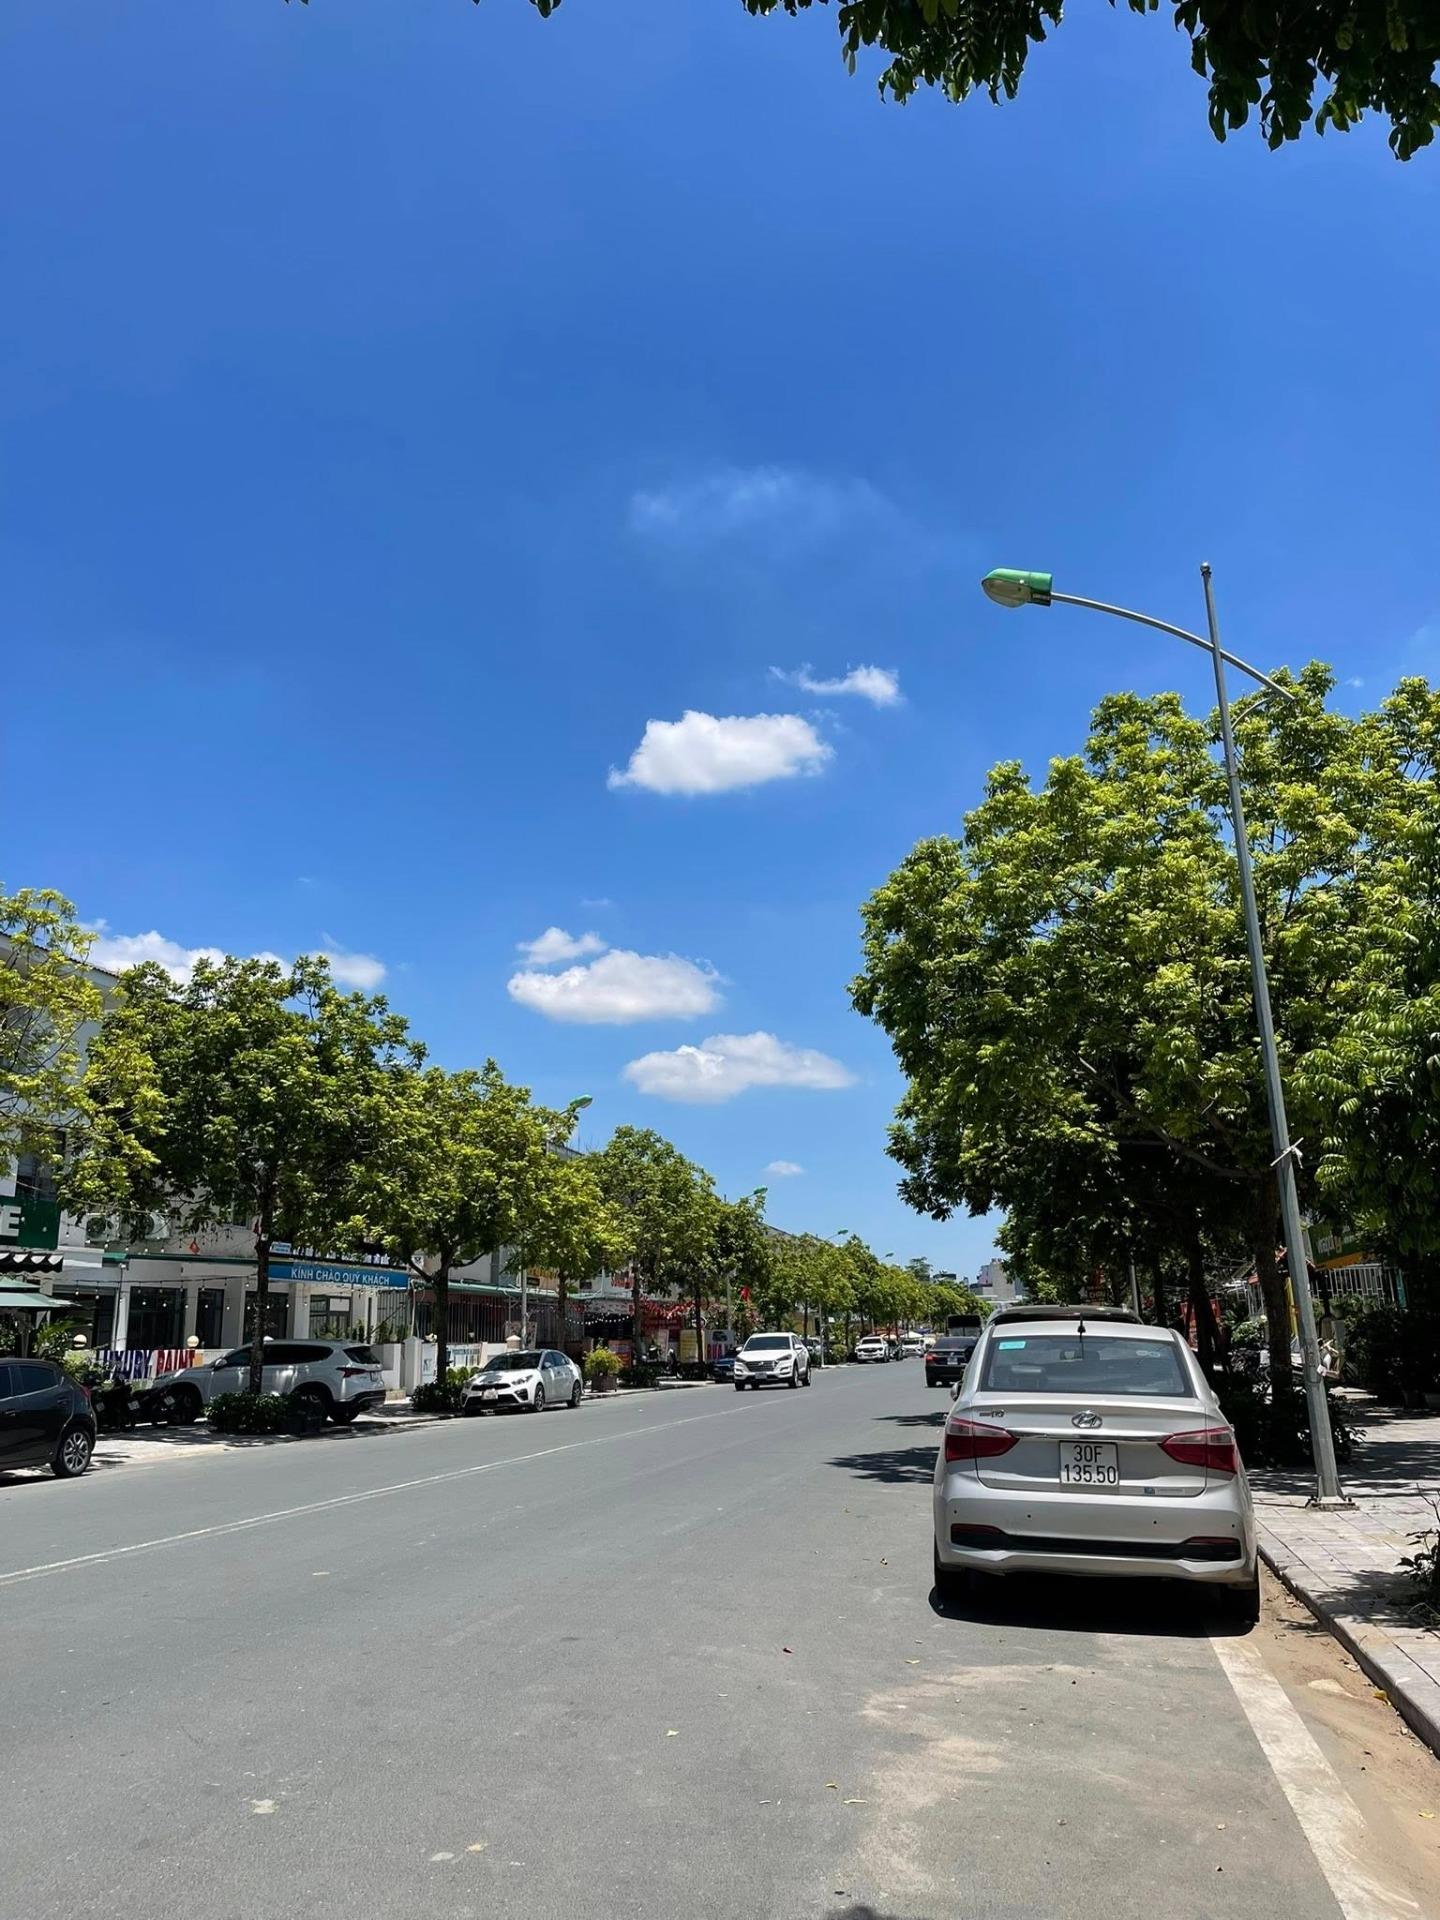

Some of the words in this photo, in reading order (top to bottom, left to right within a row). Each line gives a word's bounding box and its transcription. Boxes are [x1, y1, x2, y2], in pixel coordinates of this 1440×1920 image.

[291, 1266, 313, 1279] KÍNH
[315, 1269, 341, 1282] CHÀO
[362, 1273, 390, 1286] KHÁCH
[1073, 1444, 1103, 1463] 30F
[1064, 1463, 1116, 1484] 135.50
